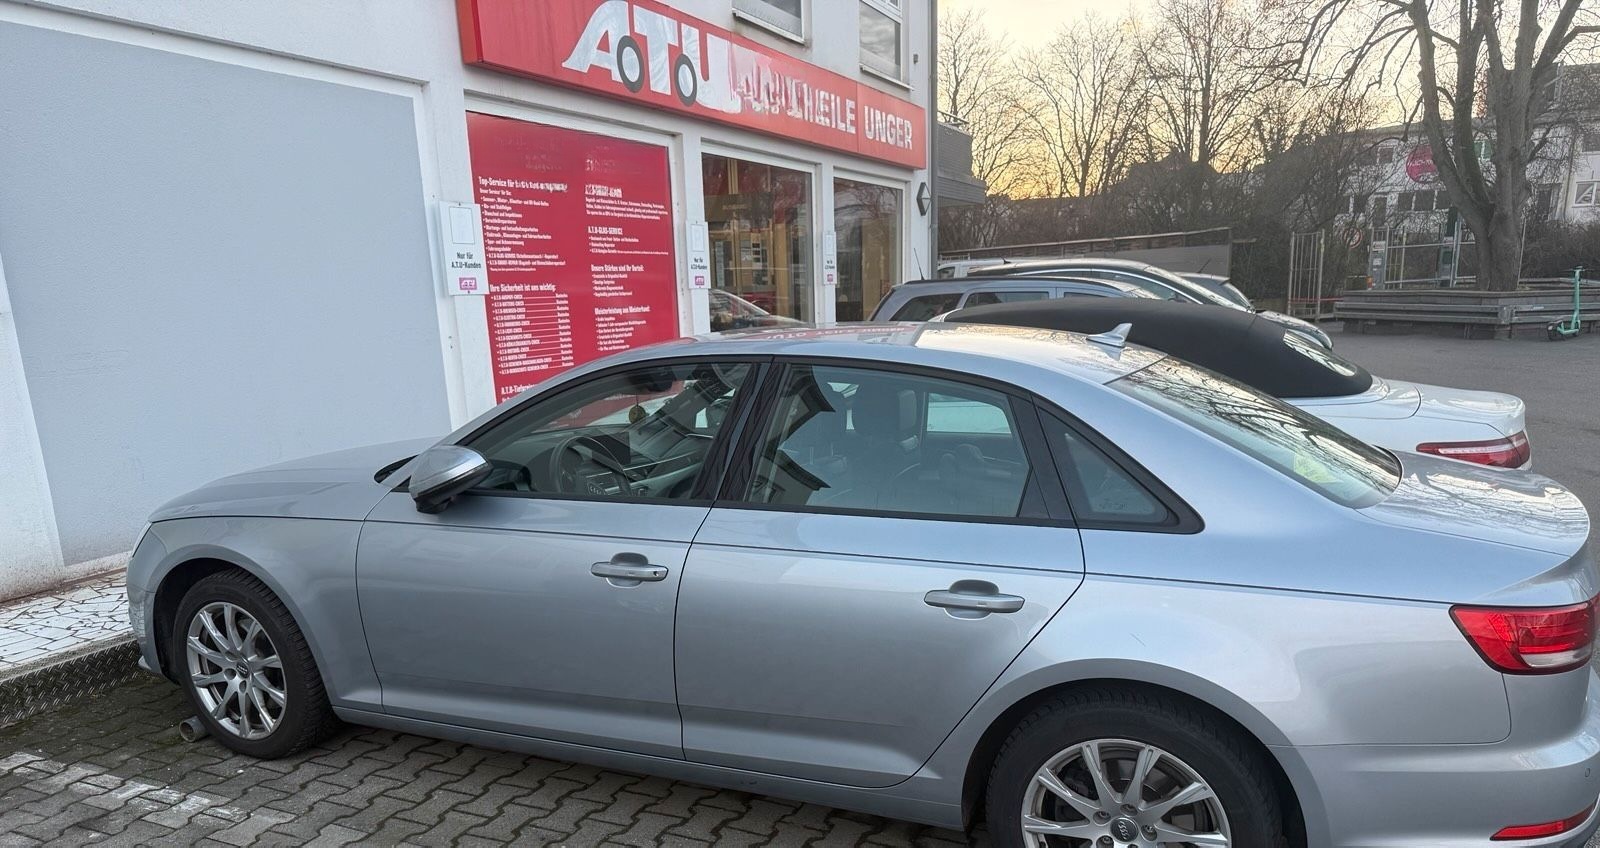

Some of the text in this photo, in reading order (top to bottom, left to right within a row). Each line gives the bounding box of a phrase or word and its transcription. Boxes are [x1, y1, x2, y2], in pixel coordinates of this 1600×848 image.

[864, 105, 913, 150] UNGER
[489, 284, 500, 292] Ihre
[500, 283, 523, 292] Sicherheit
